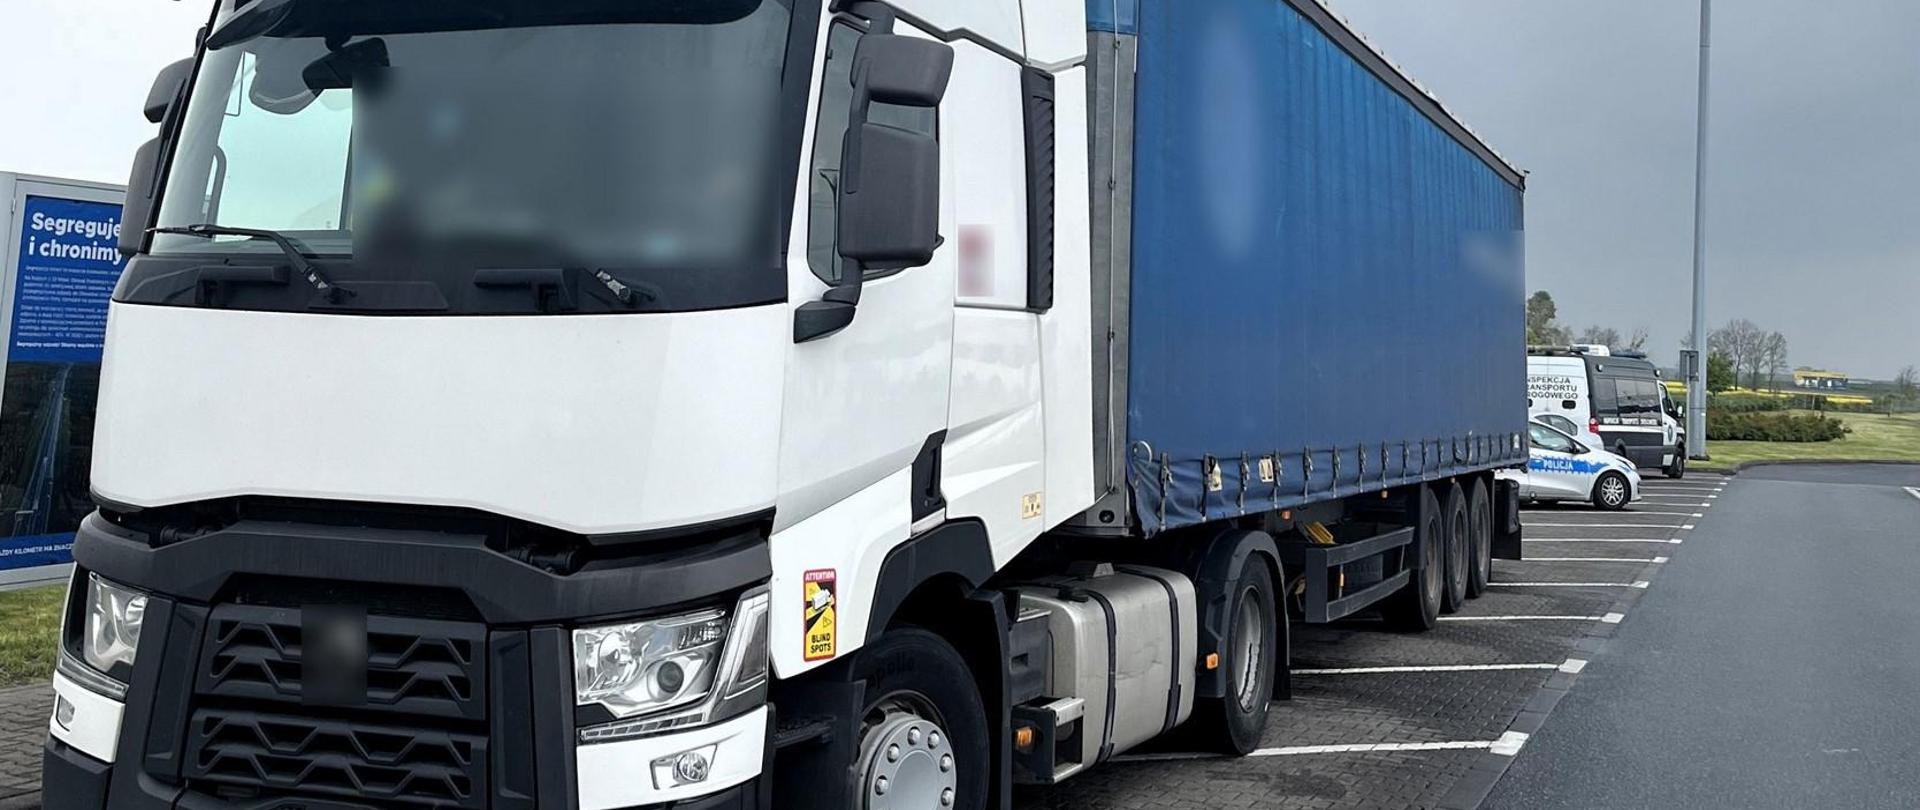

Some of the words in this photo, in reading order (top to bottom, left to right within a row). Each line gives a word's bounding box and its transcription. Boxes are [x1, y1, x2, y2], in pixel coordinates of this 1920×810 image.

[28, 236, 35, 255] i
[39, 239, 122, 265] chronimy
[1543, 459, 1574, 470] POLICJA
[812, 633, 831, 643] BLIND
[810, 643, 832, 654] SPOTS
